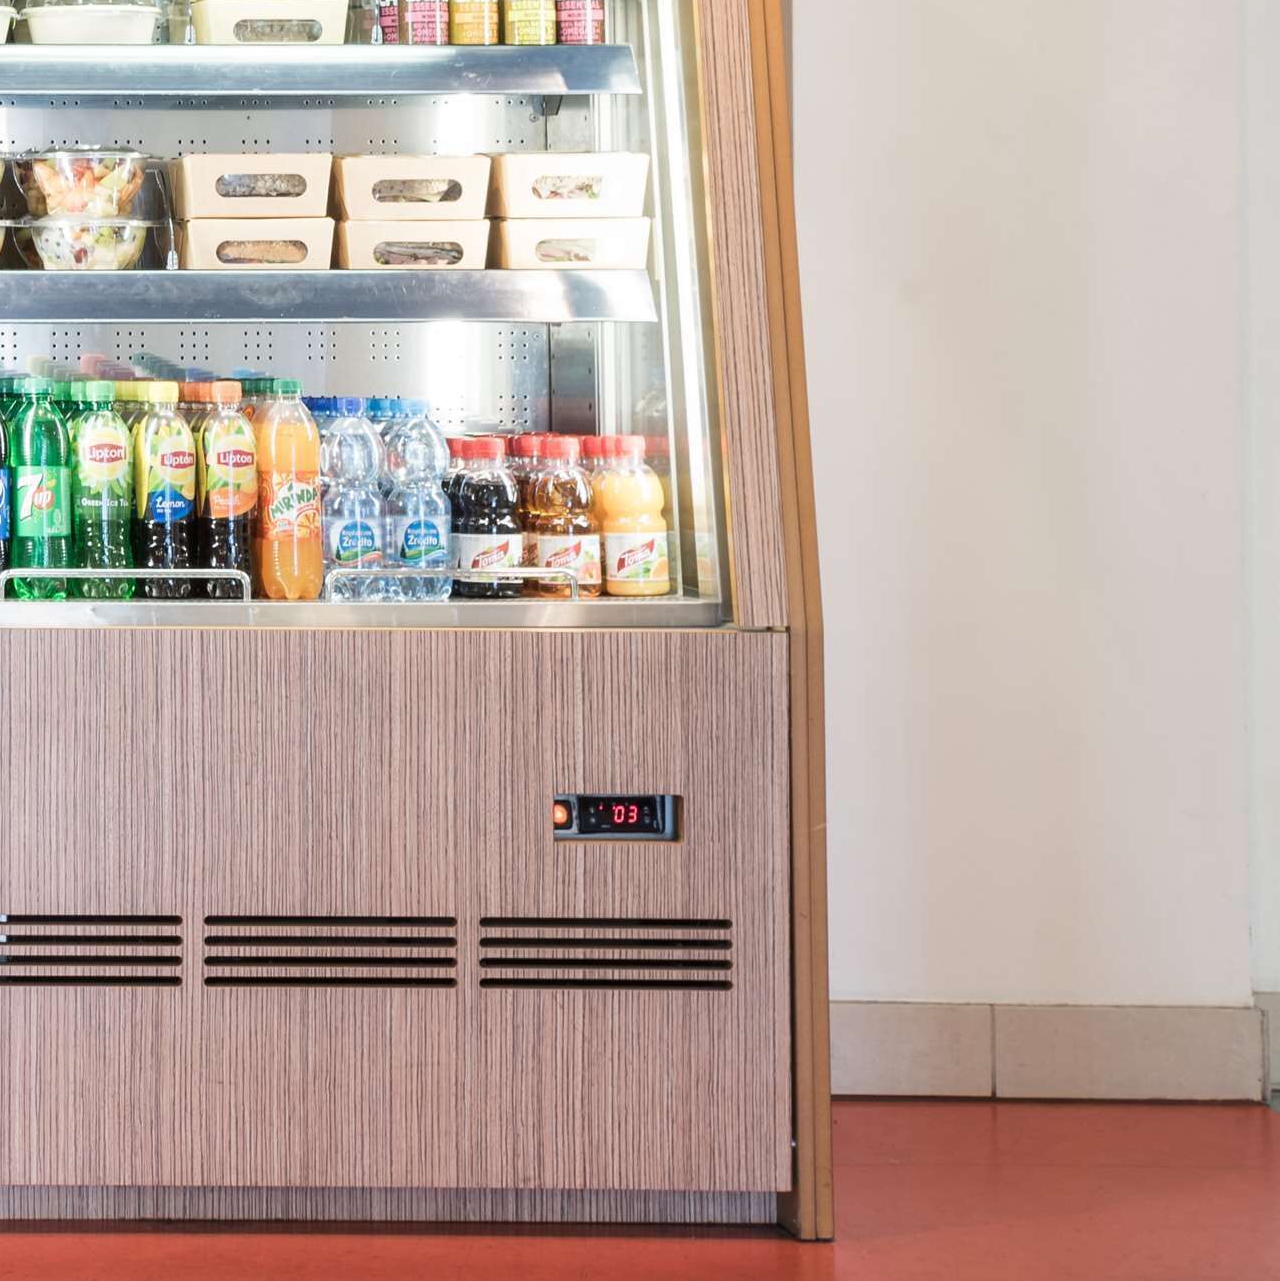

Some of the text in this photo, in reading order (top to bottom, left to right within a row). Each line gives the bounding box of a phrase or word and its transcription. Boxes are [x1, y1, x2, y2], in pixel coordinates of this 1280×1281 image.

[163, 453, 195, 466] Lipton
[219, 453, 253, 465] Lipton
[155, 496, 186, 509] Lemon
[270, 487, 319, 519] MIRNDA
[613, 805, 638, 823] 03
